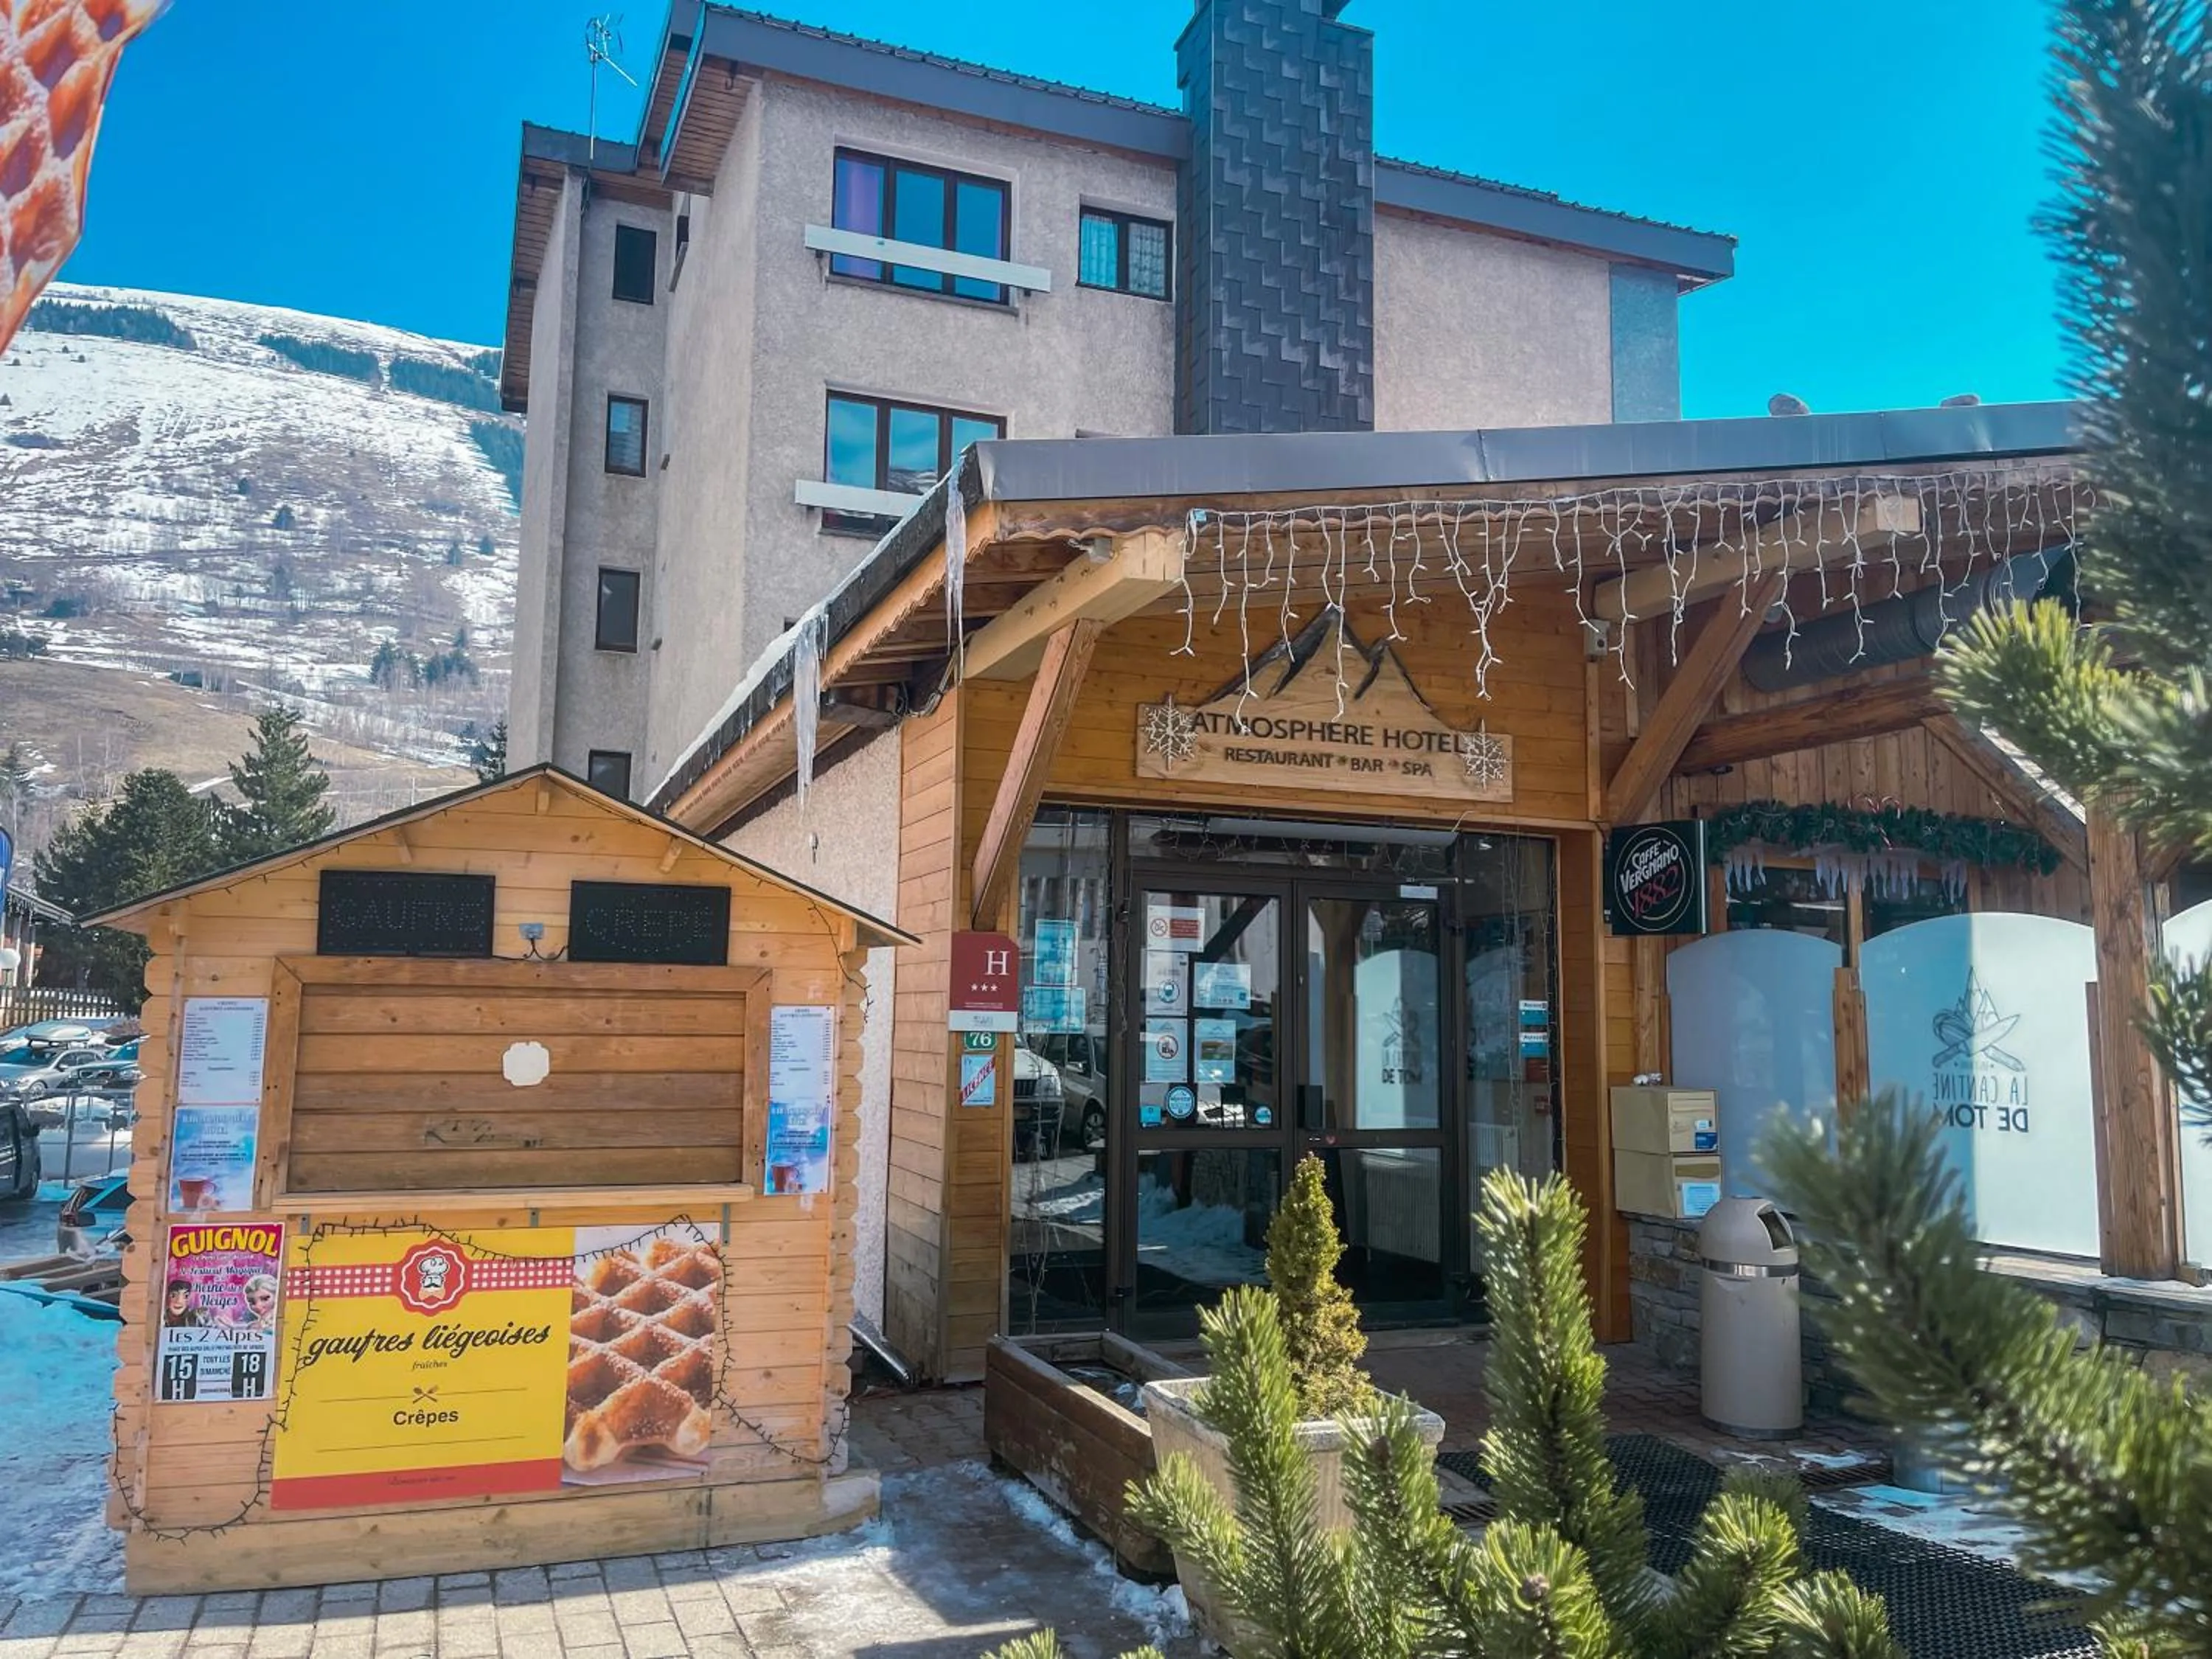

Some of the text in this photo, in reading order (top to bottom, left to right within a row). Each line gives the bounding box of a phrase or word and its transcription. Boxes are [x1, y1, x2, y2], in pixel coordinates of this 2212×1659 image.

[1191, 712, 1467, 754] ATMOSPHERE HOTEL
[1225, 747, 1433, 777] RESTAURANT BAR SPA
[1634, 866, 1680, 919] 1882
[335, 899, 481, 931] GAUFRE
[586, 908, 712, 939] CREPE
[985, 950, 1011, 975] H
[970, 1032, 992, 1047] 76
[171, 1227, 278, 1258] GUIGNOL
[199, 1329, 209, 1343] 2
[298, 1321, 551, 1364] gaufres liégeoises
[168, 1354, 192, 1380] 15
[241, 1353, 260, 1374] 18
[172, 1380, 185, 1399] H
[243, 1377, 256, 1398] H
[392, 1407, 459, 1427] Crêpes
